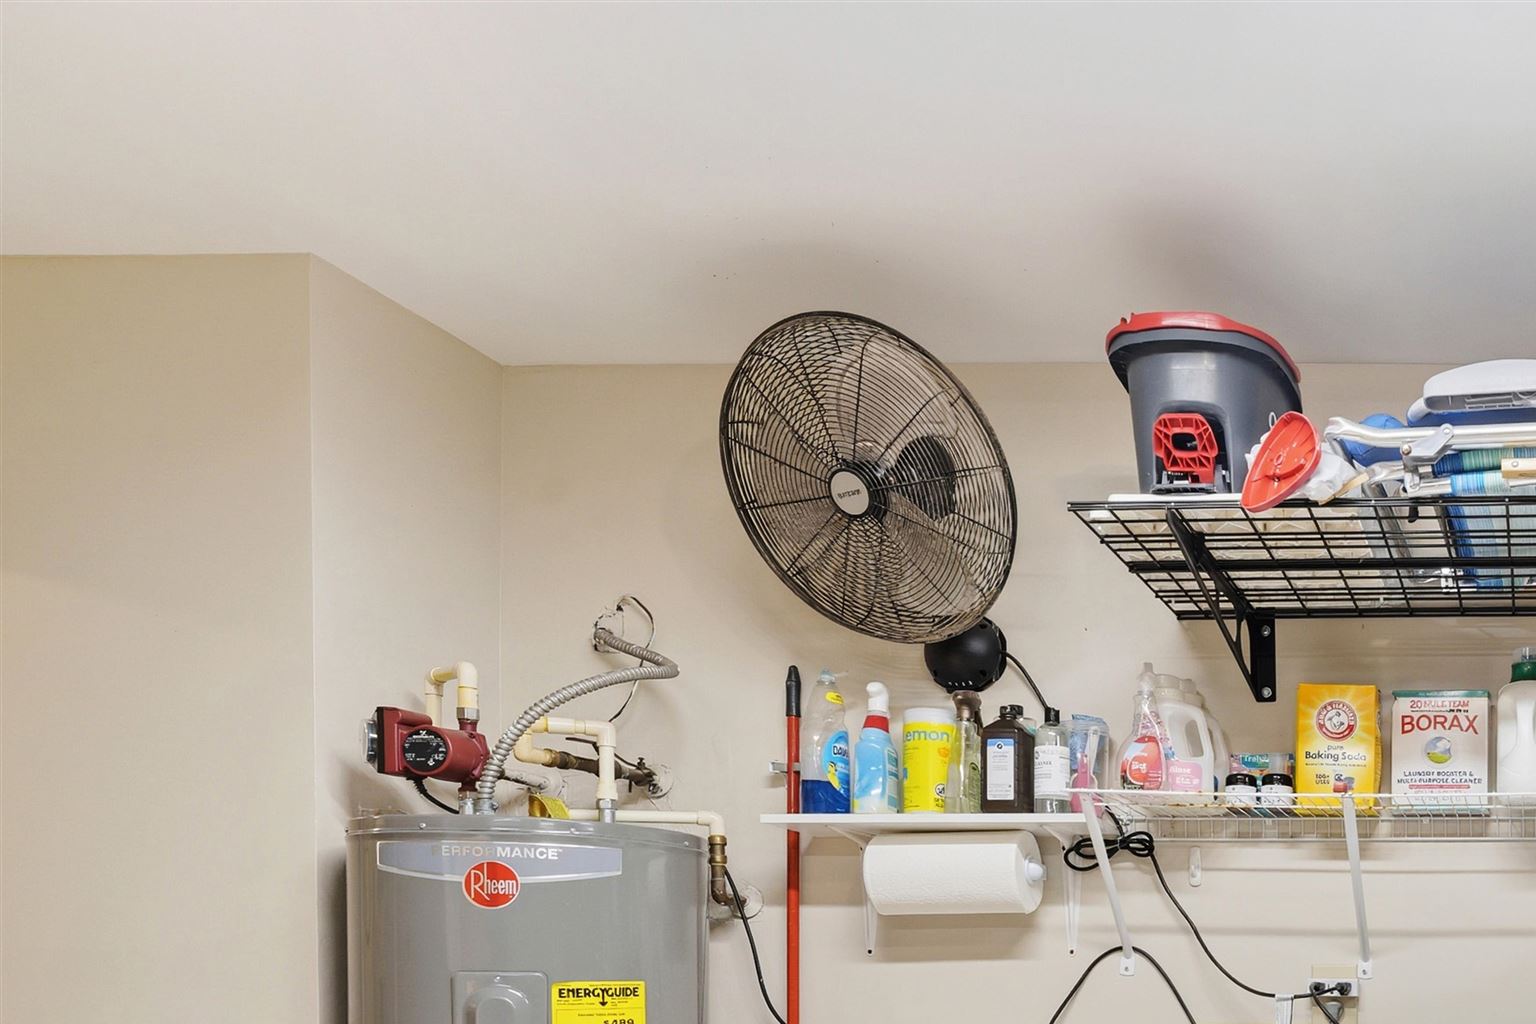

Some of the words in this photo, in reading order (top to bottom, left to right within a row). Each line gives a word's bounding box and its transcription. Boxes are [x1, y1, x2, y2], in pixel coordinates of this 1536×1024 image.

[1410, 700, 1422, 709] 20
[1401, 714, 1479, 735] BORAX
[1305, 750, 1340, 762] Baking
[1341, 752, 1367, 761] Soda
[470, 862, 517, 901] Rheem
